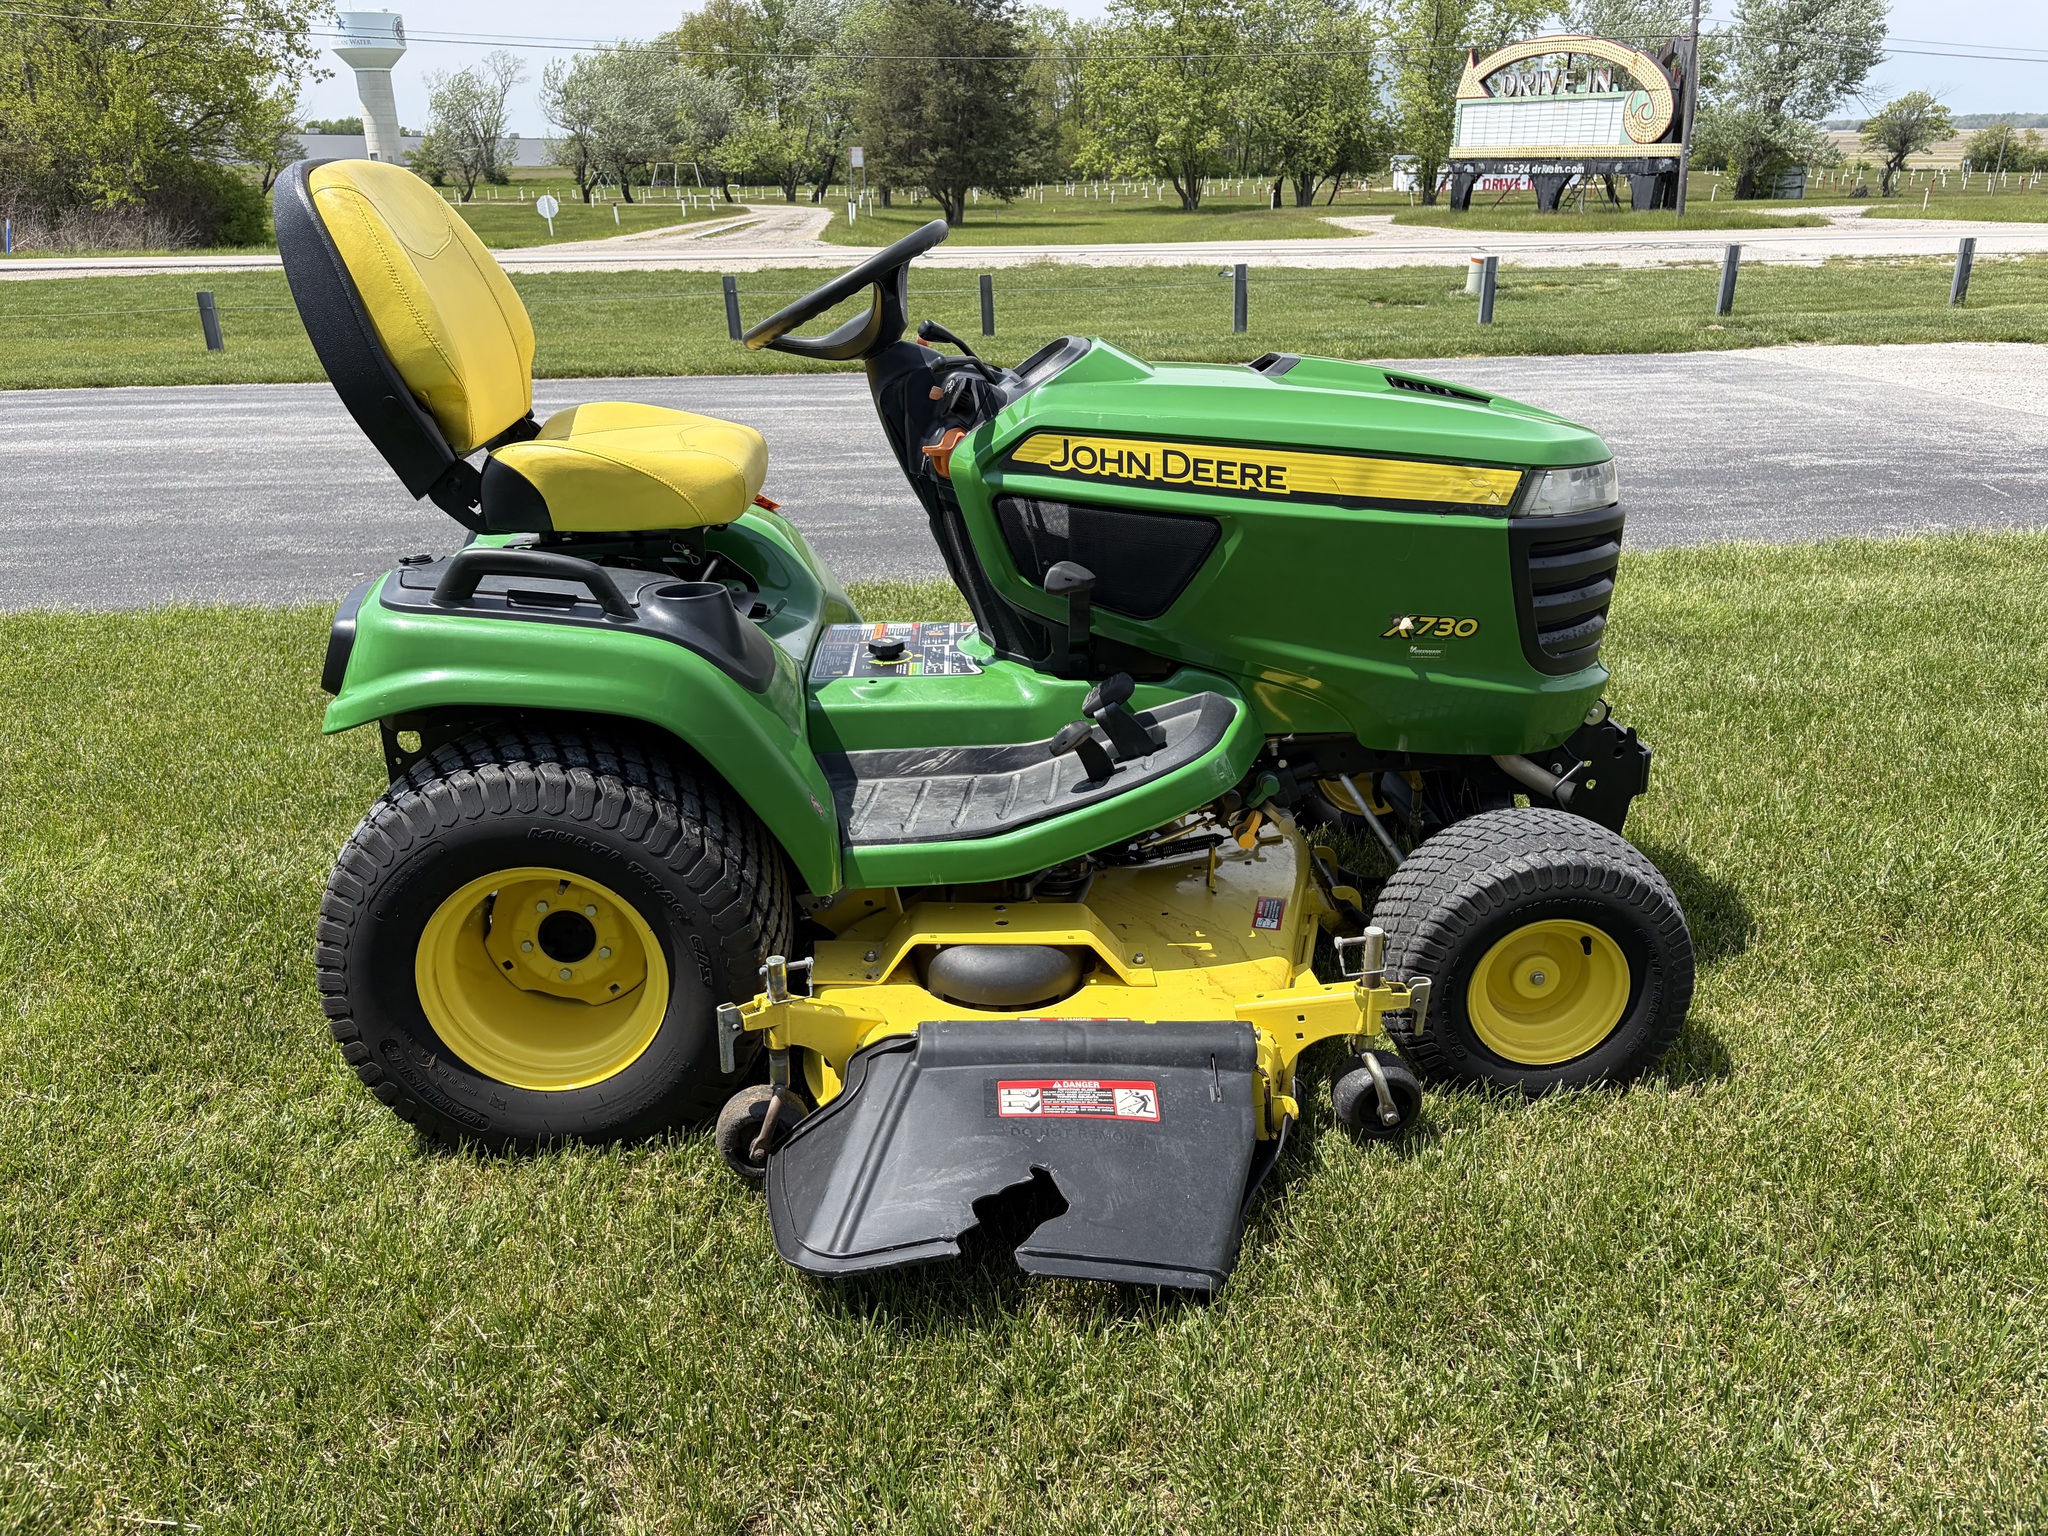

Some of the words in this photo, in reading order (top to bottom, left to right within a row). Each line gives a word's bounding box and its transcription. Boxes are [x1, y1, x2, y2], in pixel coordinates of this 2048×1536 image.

[1501, 67, 1577, 97] DRIVE
[1586, 65, 1614, 94] IN
[1503, 164, 1530, 174] 13-24
[1049, 438, 1152, 477] JOHN
[1162, 448, 1289, 491] DEERE
[1379, 614, 1480, 639] X730
[527, 827, 621, 860] MULTI
[627, 860, 693, 926] TRAC
